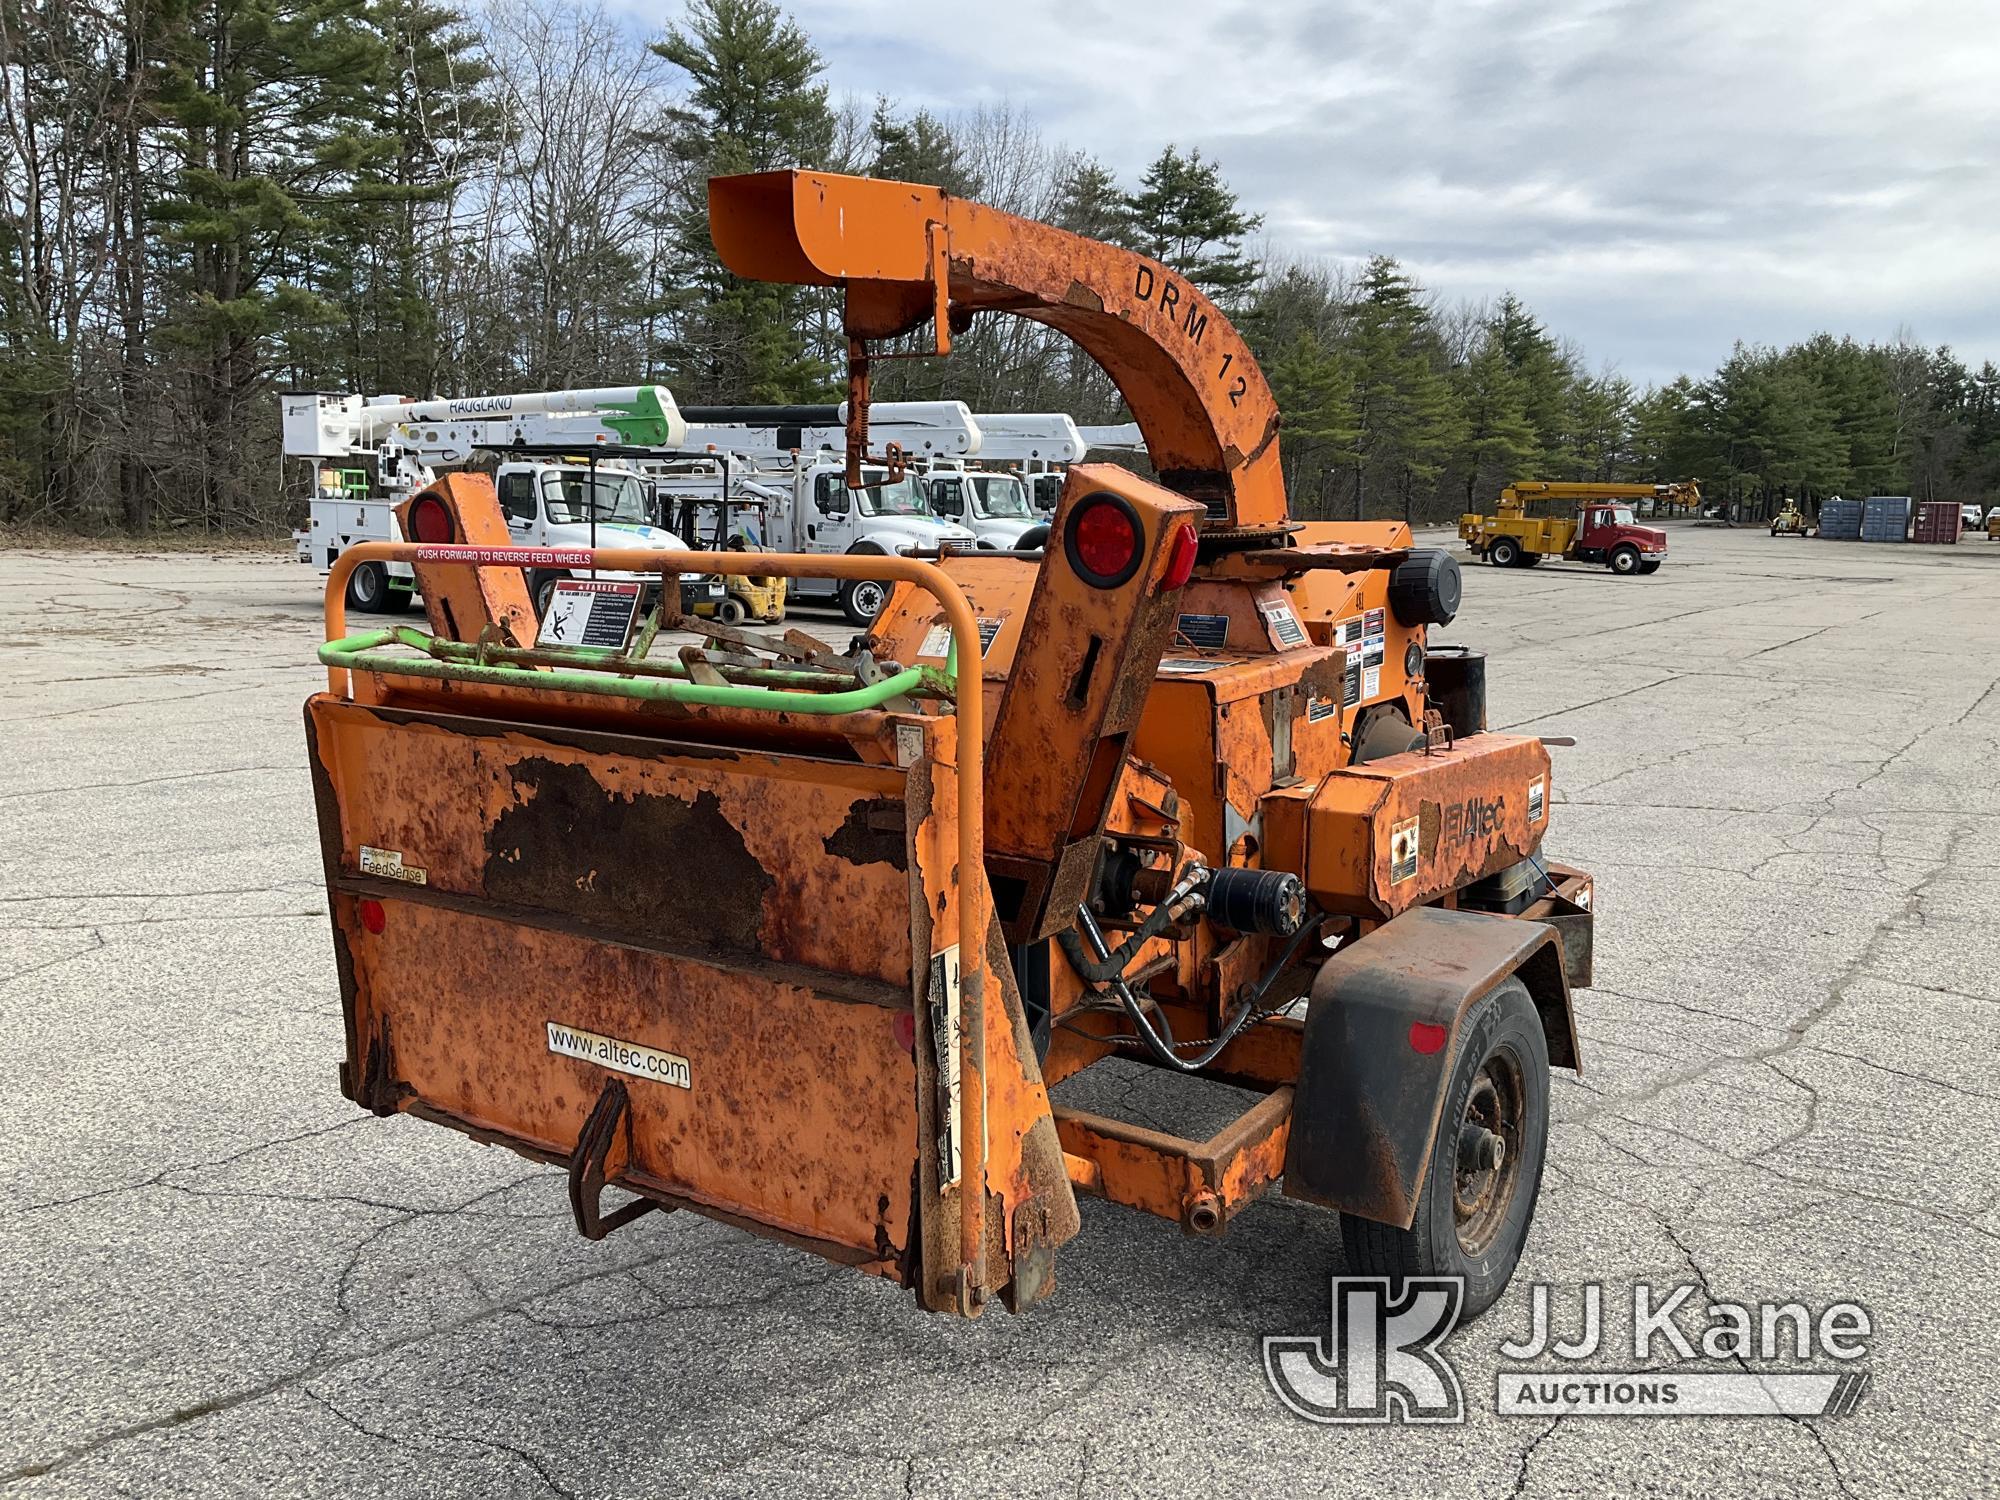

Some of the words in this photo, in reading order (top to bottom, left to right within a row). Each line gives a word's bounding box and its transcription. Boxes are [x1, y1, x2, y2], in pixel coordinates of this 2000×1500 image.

[1134, 264, 1208, 346] DRM
[1218, 353, 1247, 408] 12
[449, 397, 513, 414] HAUGLAND
[417, 549, 439, 560] PUSH
[440, 550, 478, 562] FORWARD
[480, 551, 491, 562] TO
[492, 551, 530, 563] REVERSE
[531, 553, 552, 564] FEED
[554, 553, 591, 565] WHEELS
[585, 583, 618, 592] DANGER
[1464, 796, 1505, 838] Altec
[361, 847, 386, 859] Equipped
[362, 857, 422, 882] FeedSense
[550, 1029, 688, 1081] www.altec.com
[1453, 1079, 1468, 1128] KING
